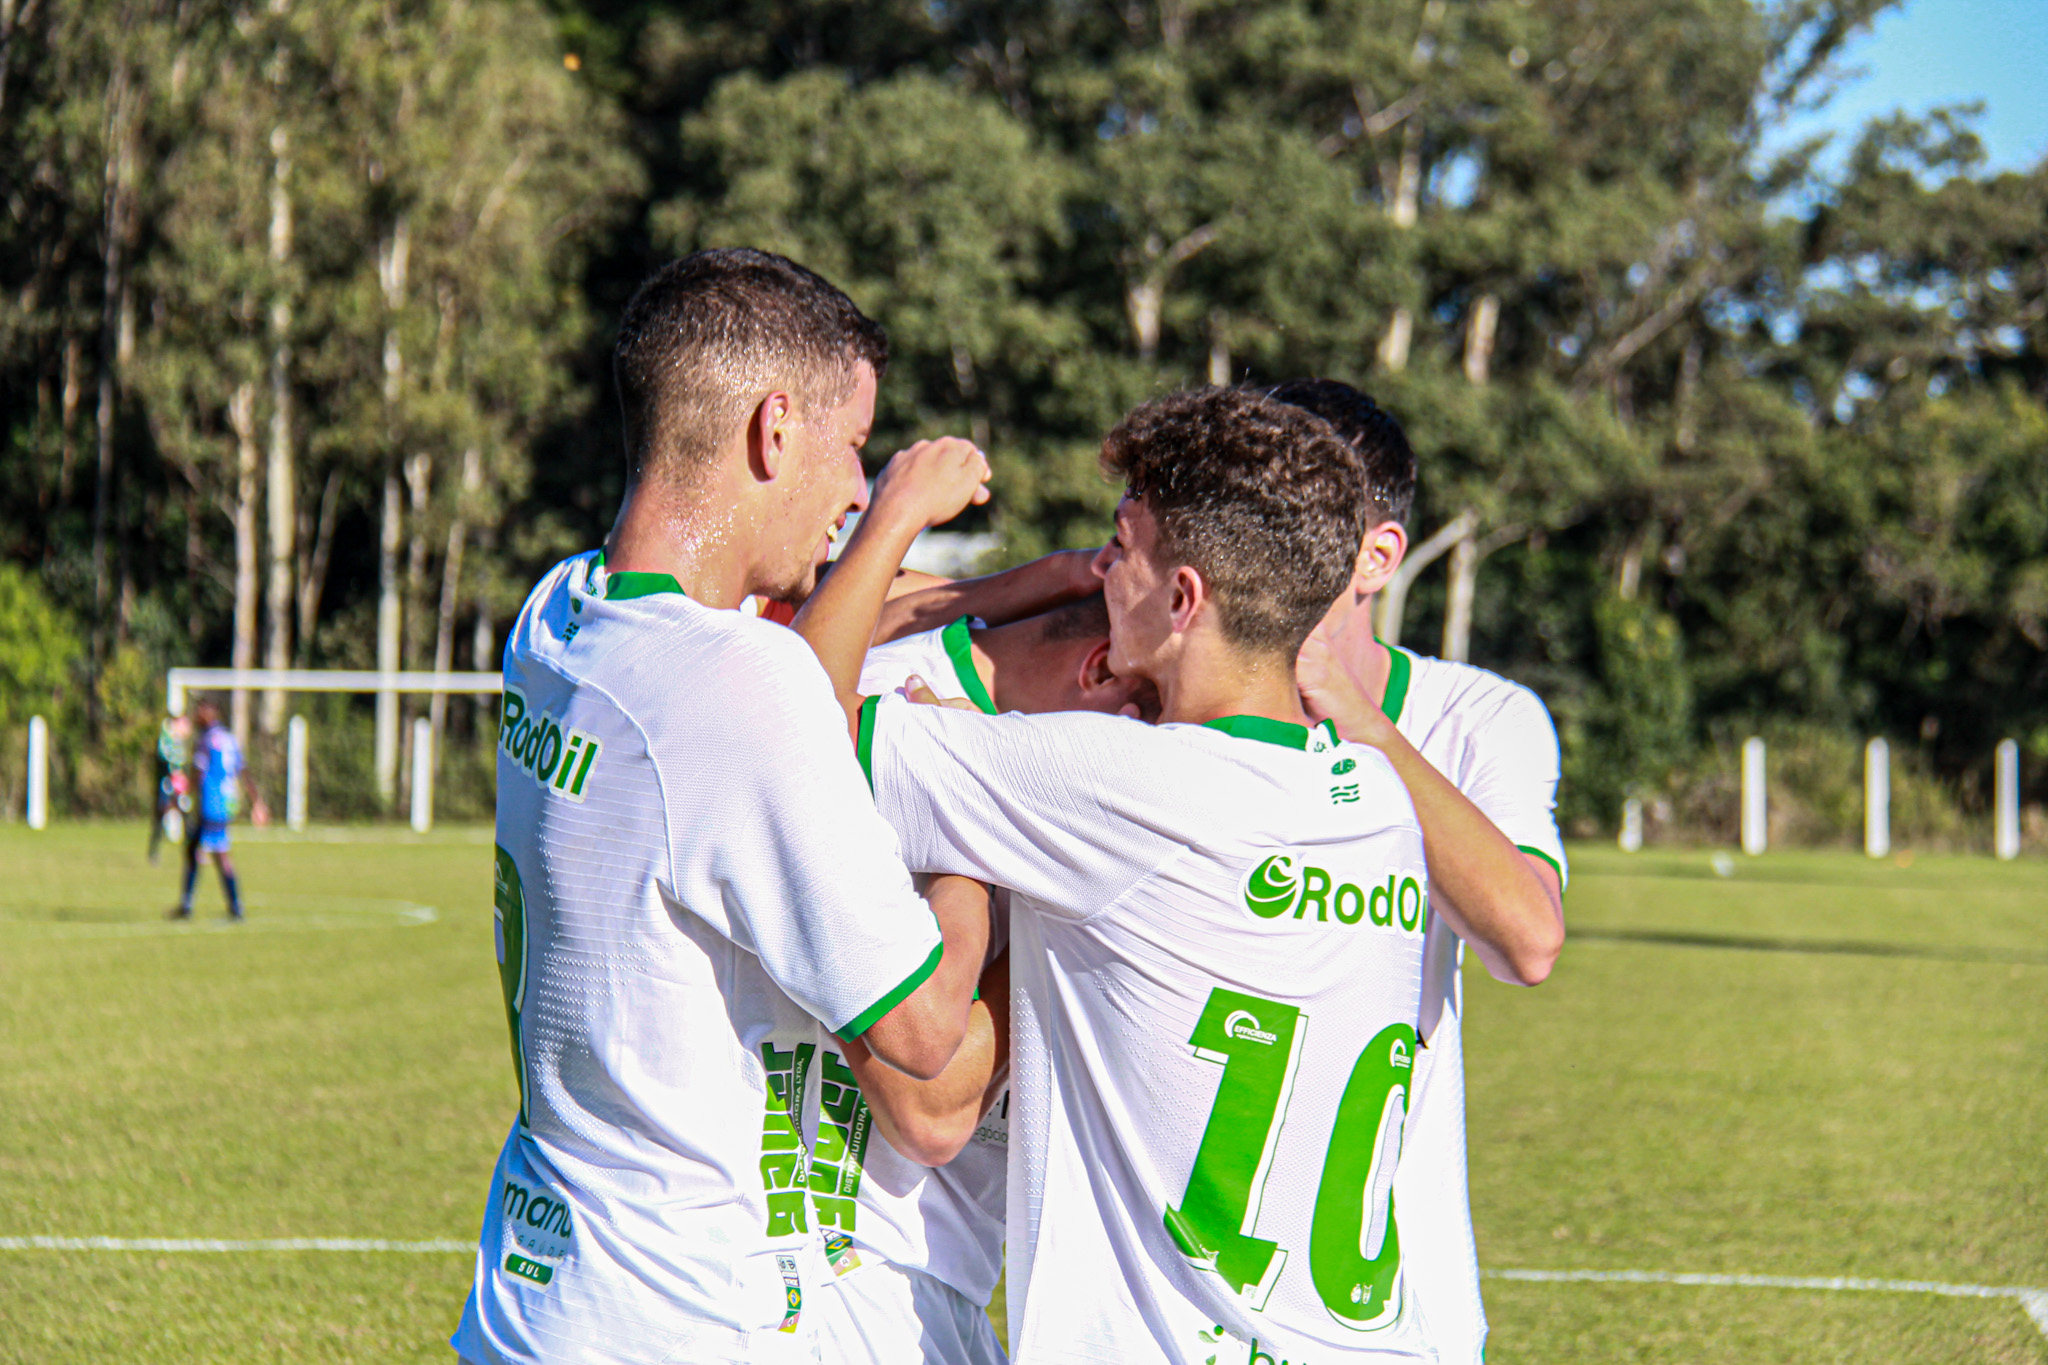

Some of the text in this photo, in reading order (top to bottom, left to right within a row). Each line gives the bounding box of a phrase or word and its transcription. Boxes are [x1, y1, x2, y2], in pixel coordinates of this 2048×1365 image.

[500, 689, 598, 796] RodOil
[1163, 987, 1417, 1331] 10
[518, 1261, 540, 1279] SUL
